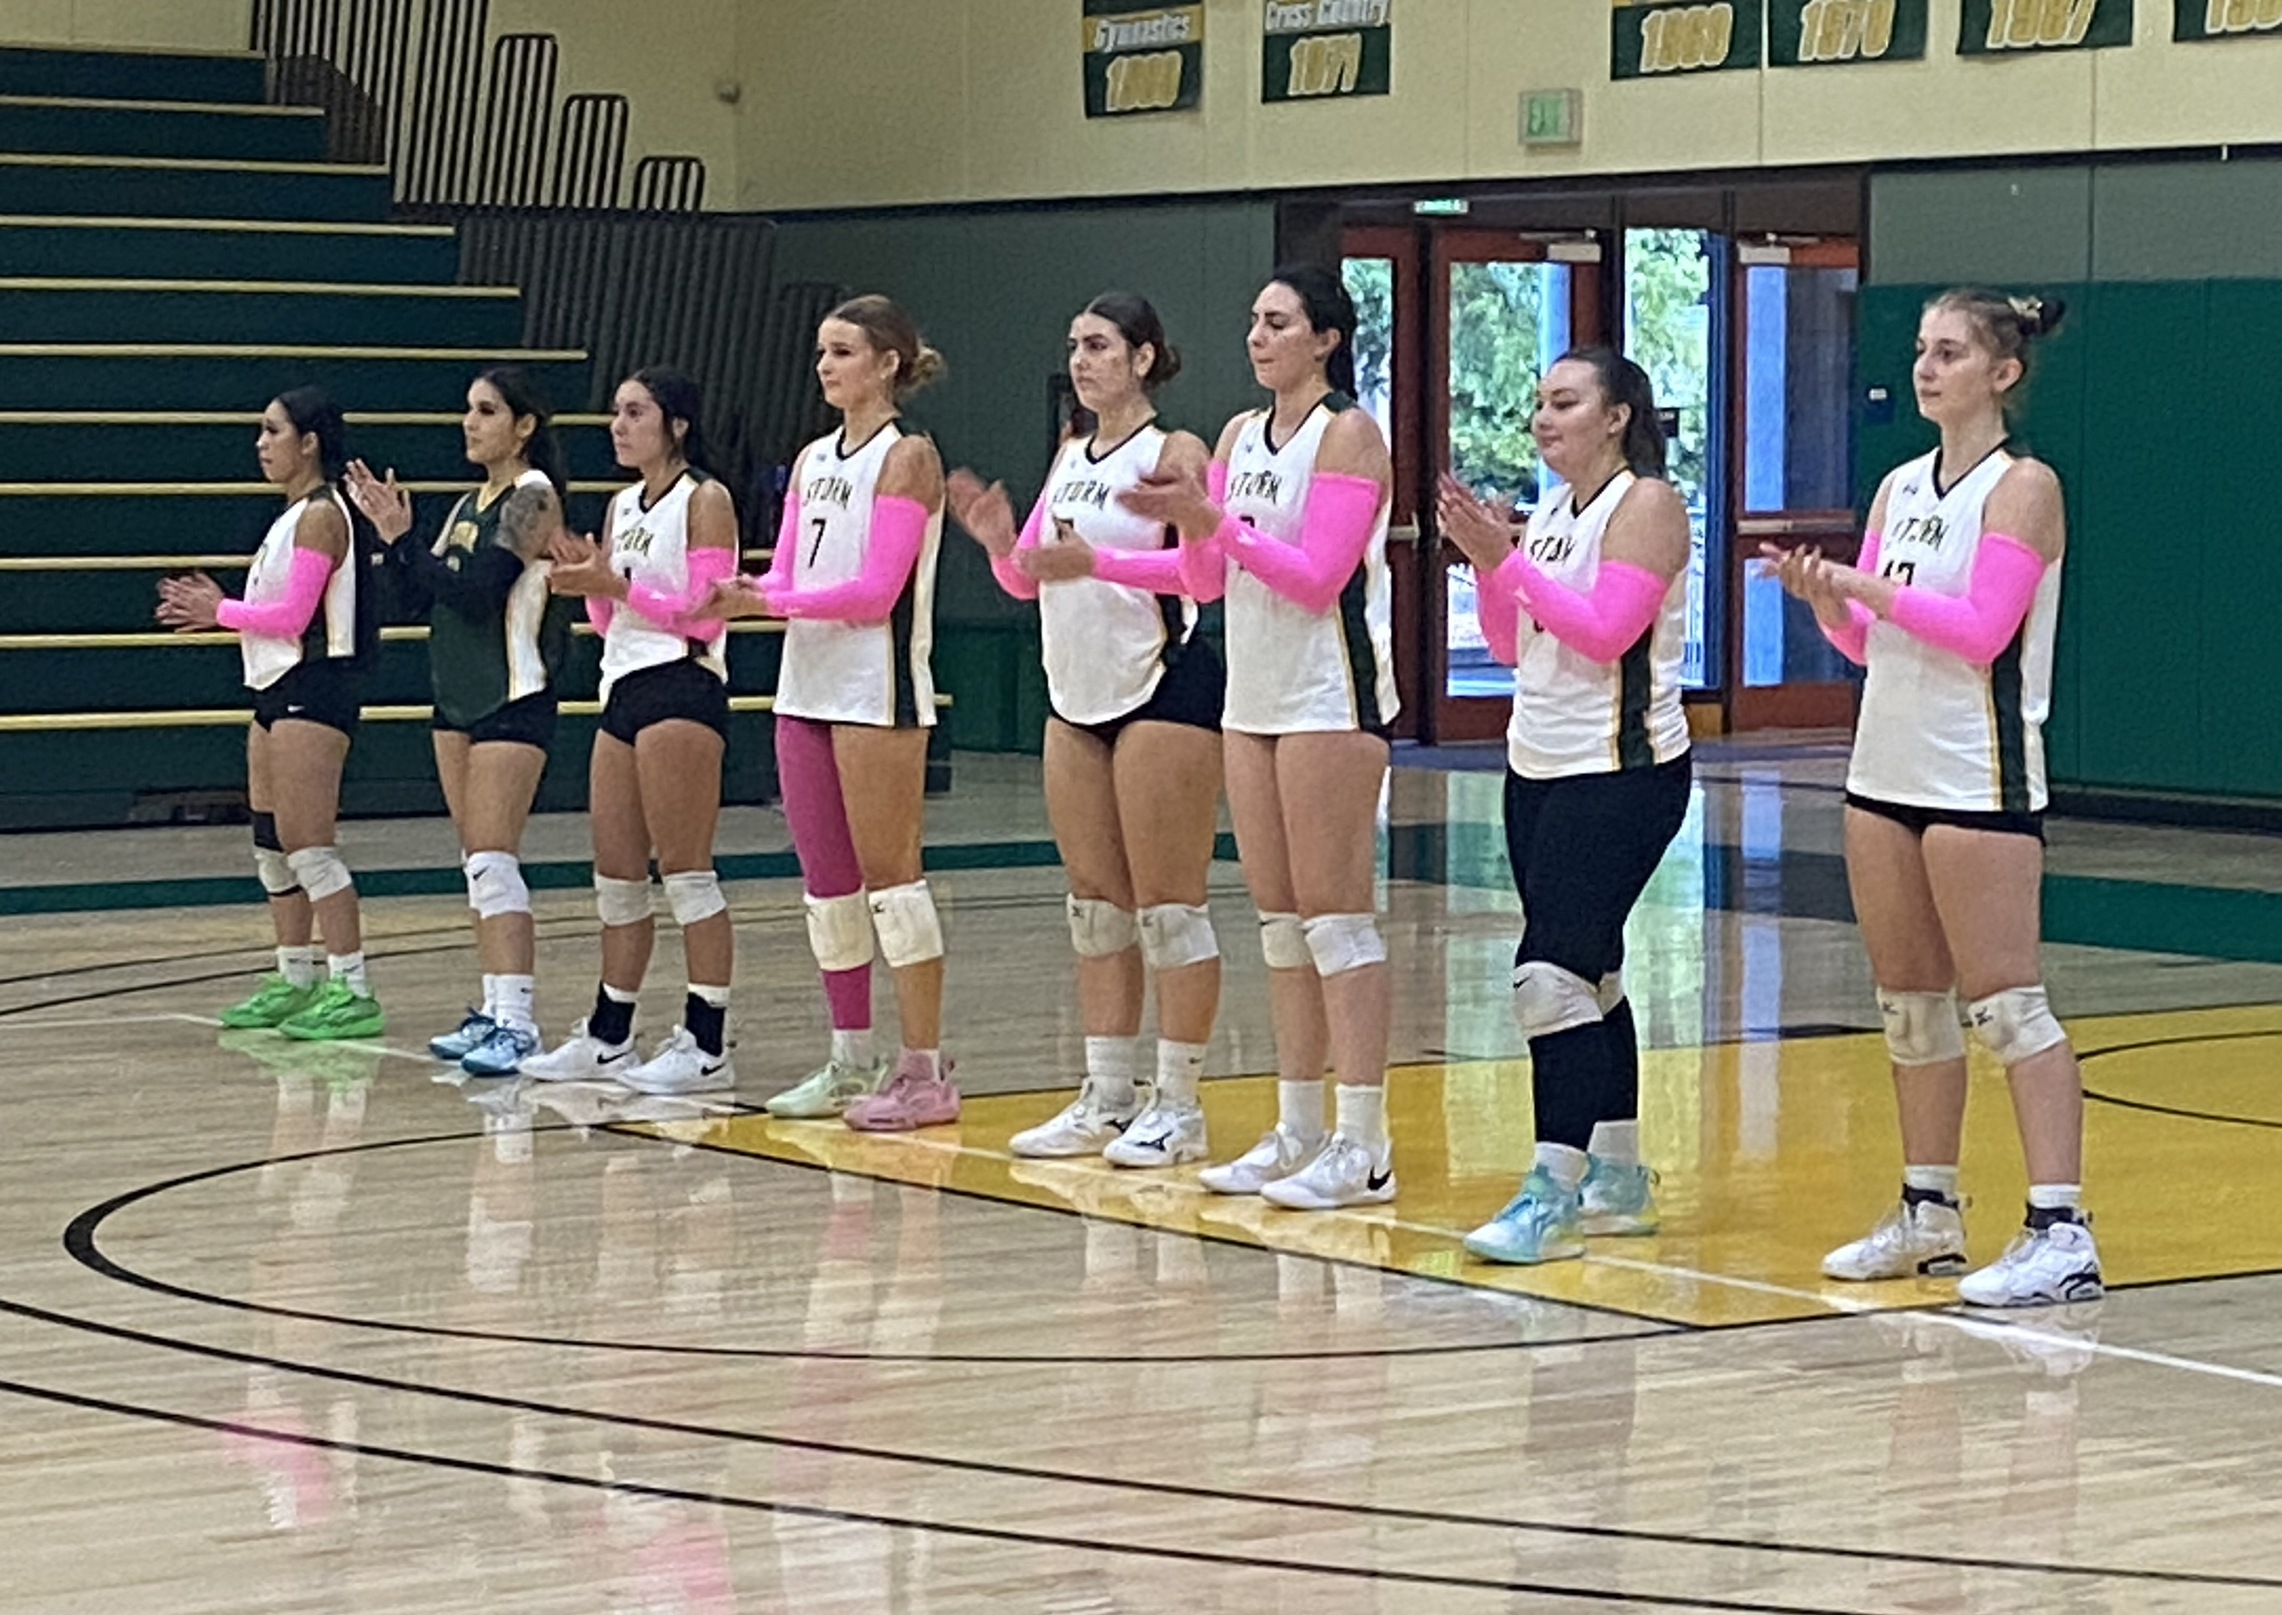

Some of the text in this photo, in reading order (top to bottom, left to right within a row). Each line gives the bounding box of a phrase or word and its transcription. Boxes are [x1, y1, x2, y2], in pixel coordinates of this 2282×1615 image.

[802, 475, 854, 511] STORM
[1052, 479, 1111, 511] STORM
[808, 518, 826, 567] 7
